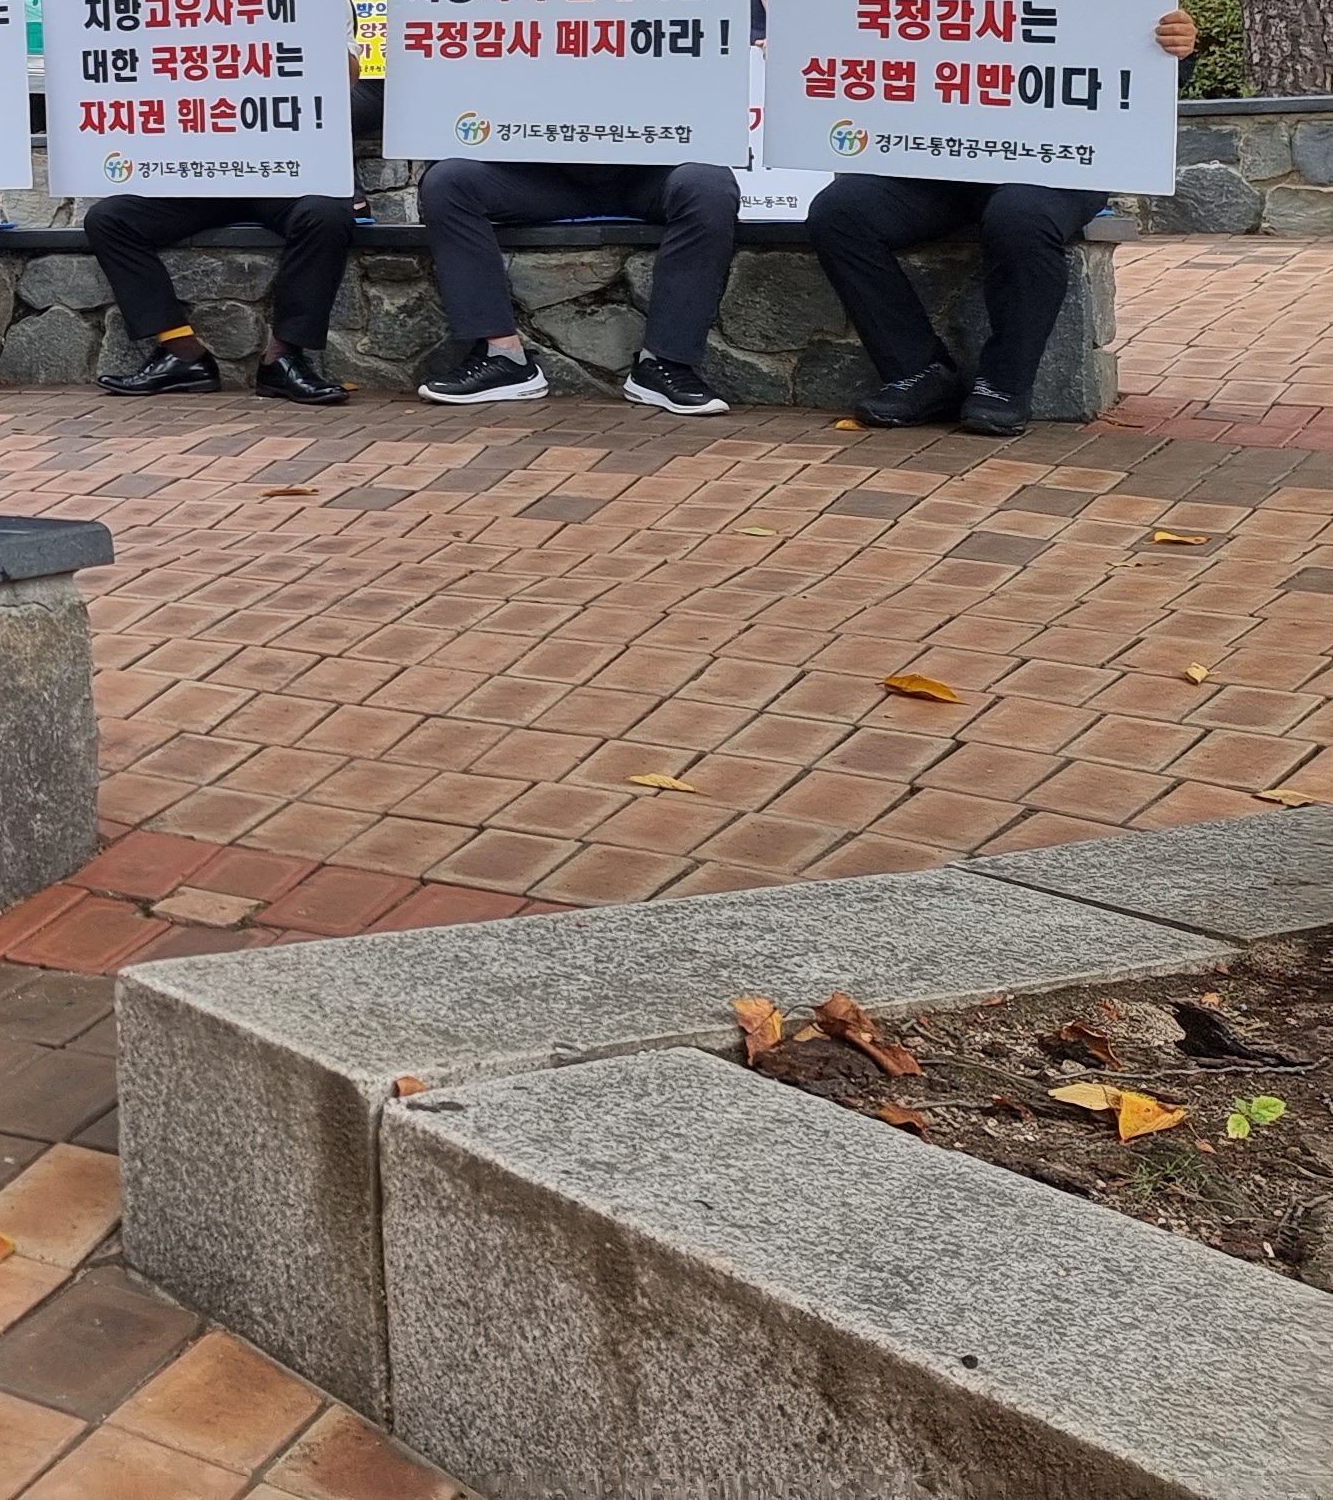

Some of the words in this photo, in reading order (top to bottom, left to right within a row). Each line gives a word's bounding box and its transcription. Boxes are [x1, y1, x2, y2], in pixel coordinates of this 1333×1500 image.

[403, 20, 542, 58] 국정감사
[556, 19, 704, 58] 폐지하라
[82, 49, 139, 84] 대한
[151, 42, 304, 81] 국정감사는
[801, 57, 916, 102] 실정법
[934, 62, 1102, 111] 위반이다
[79, 100, 166, 135] 자치권
[177, 96, 301, 134] 훼손이다
[495, 123, 693, 144] 경기도통합공무원노동조합
[874, 132, 1095, 165] 경기도통합공무원노동조합
[137, 160, 301, 179] 경기도통합공무원노동조합
